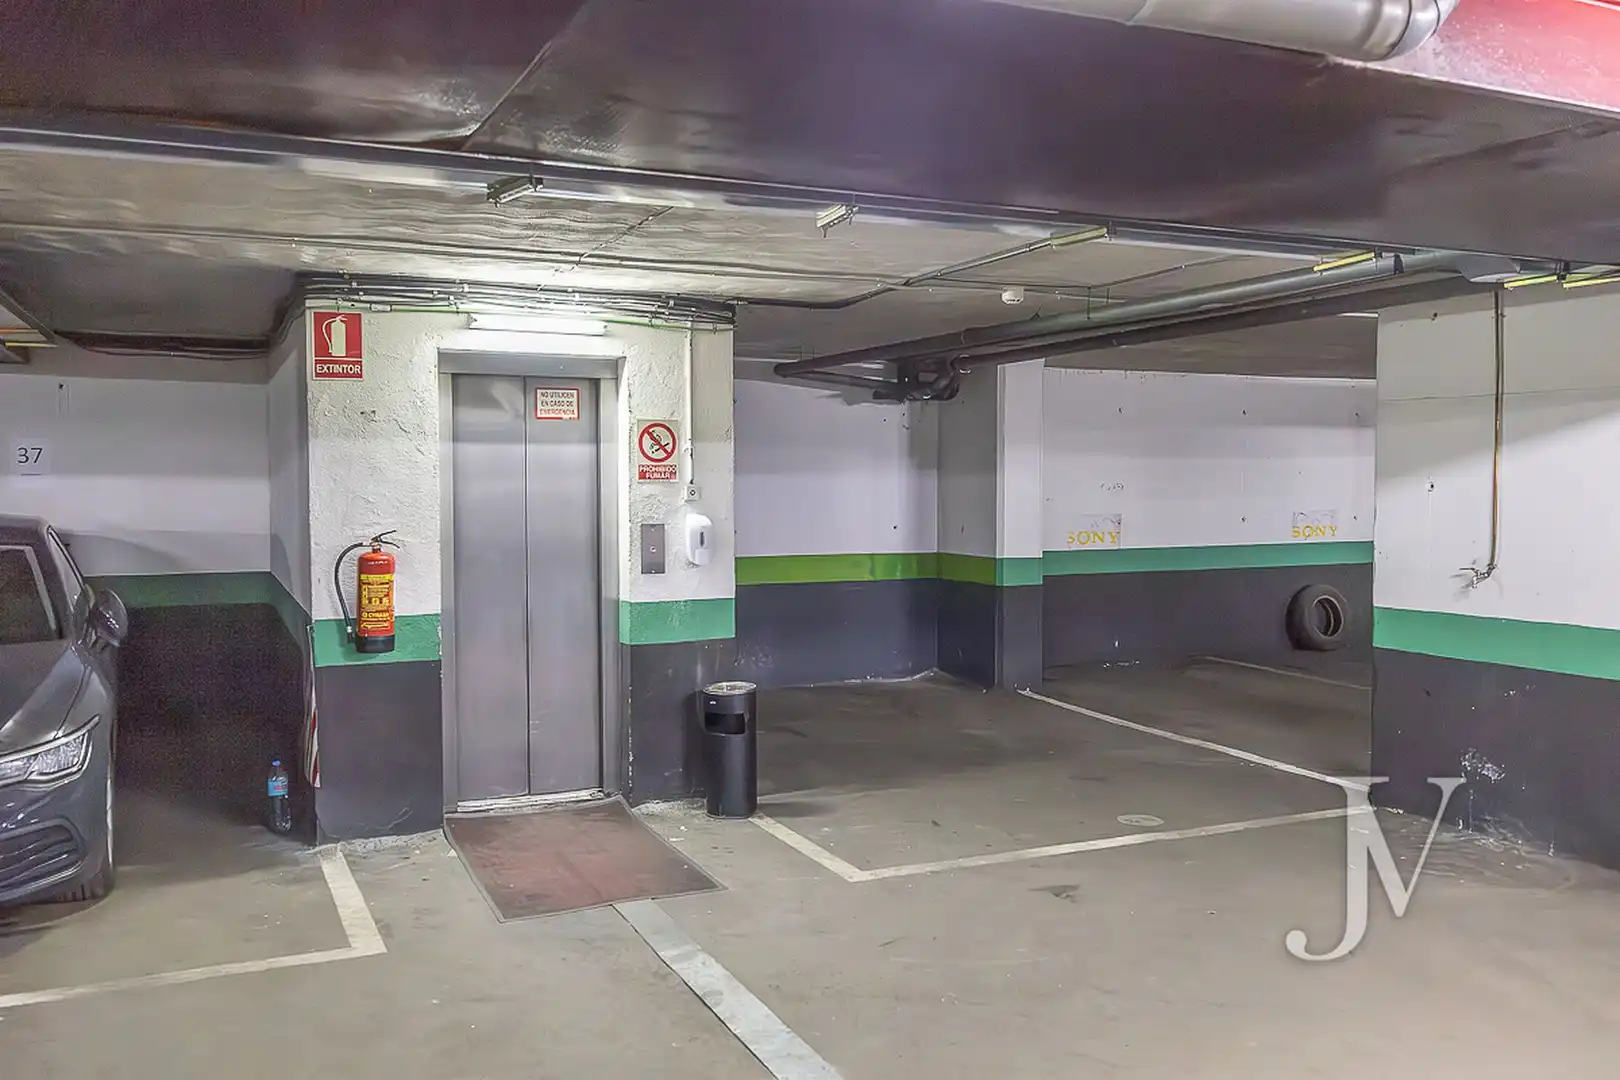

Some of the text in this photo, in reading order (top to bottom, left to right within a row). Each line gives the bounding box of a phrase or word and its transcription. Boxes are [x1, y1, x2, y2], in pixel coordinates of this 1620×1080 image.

[316, 364, 361, 374] EXTINTOR
[540, 408, 576, 416] EMERGENCIA
[17, 447, 43, 463] 37
[639, 465, 676, 473] PROHIBIDO
[1292, 525, 1337, 538] SONY
[1067, 531, 1121, 545] SONY
